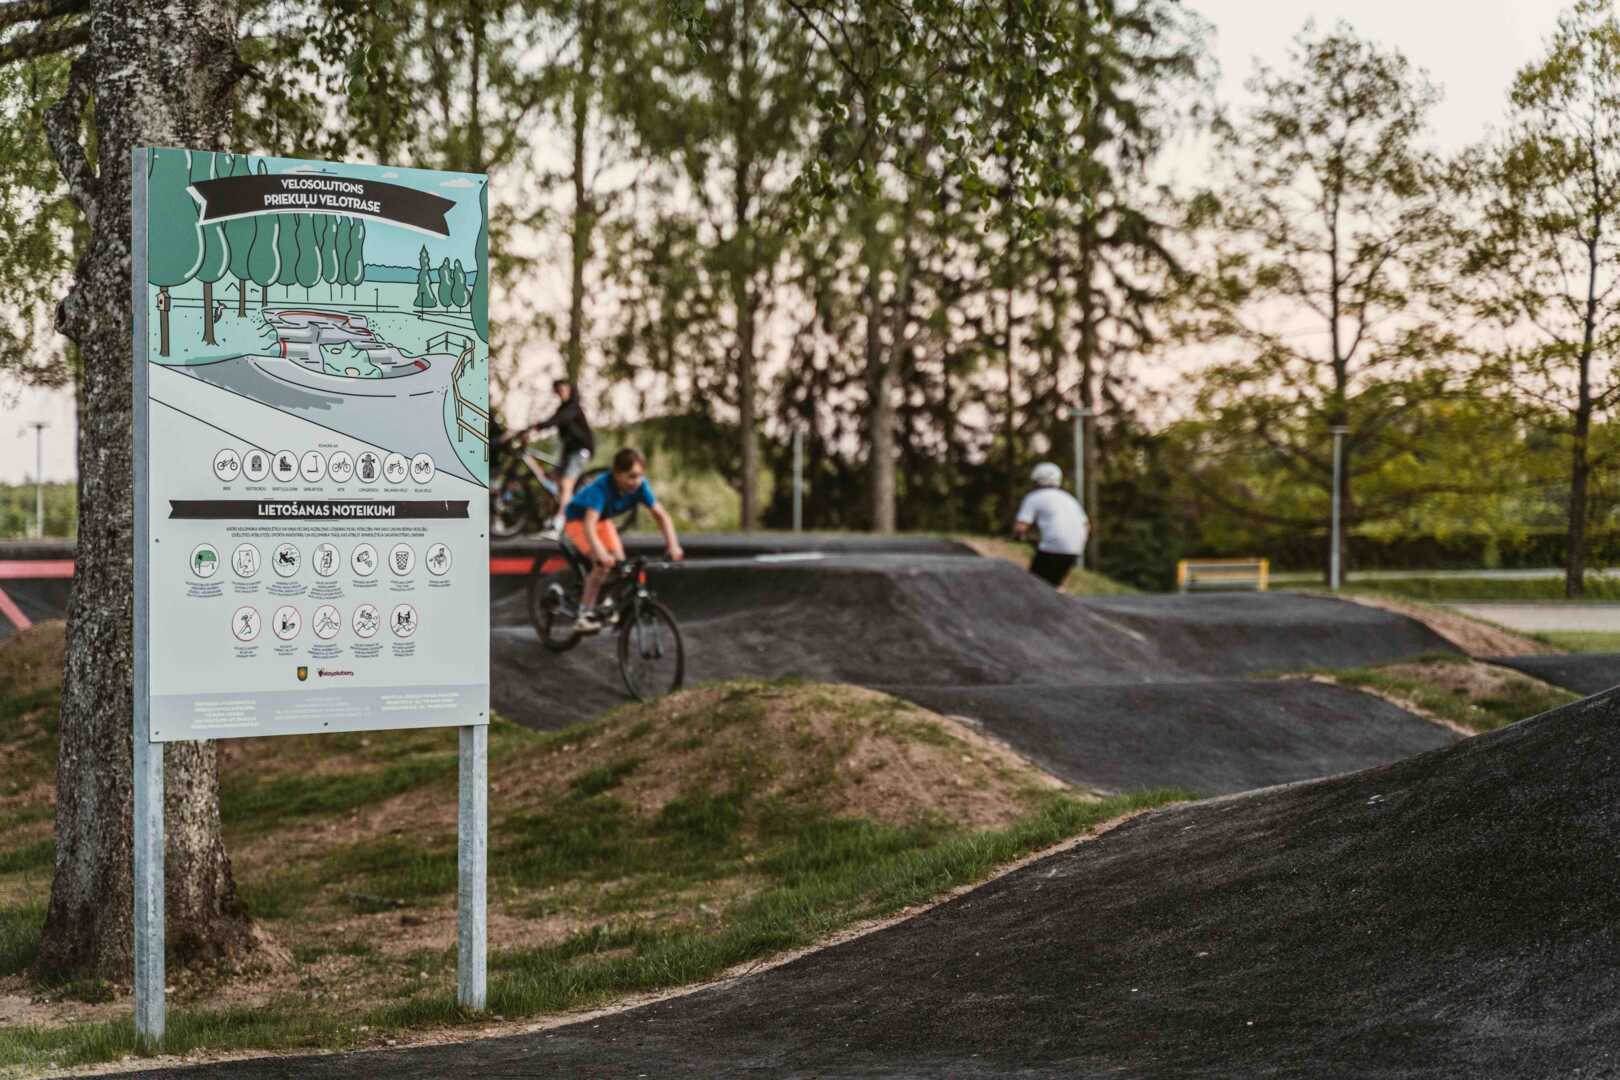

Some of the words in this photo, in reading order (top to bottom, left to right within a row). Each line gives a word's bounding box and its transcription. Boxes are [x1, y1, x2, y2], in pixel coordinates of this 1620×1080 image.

[281, 178, 365, 195] VELOSOLUTIONS
[263, 193, 318, 209] PRIEKUĻU
[319, 194, 382, 213] VELOTRASE
[258, 501, 330, 516] LIETOŠANAS
[332, 504, 396, 516] NOTEIKUMI
